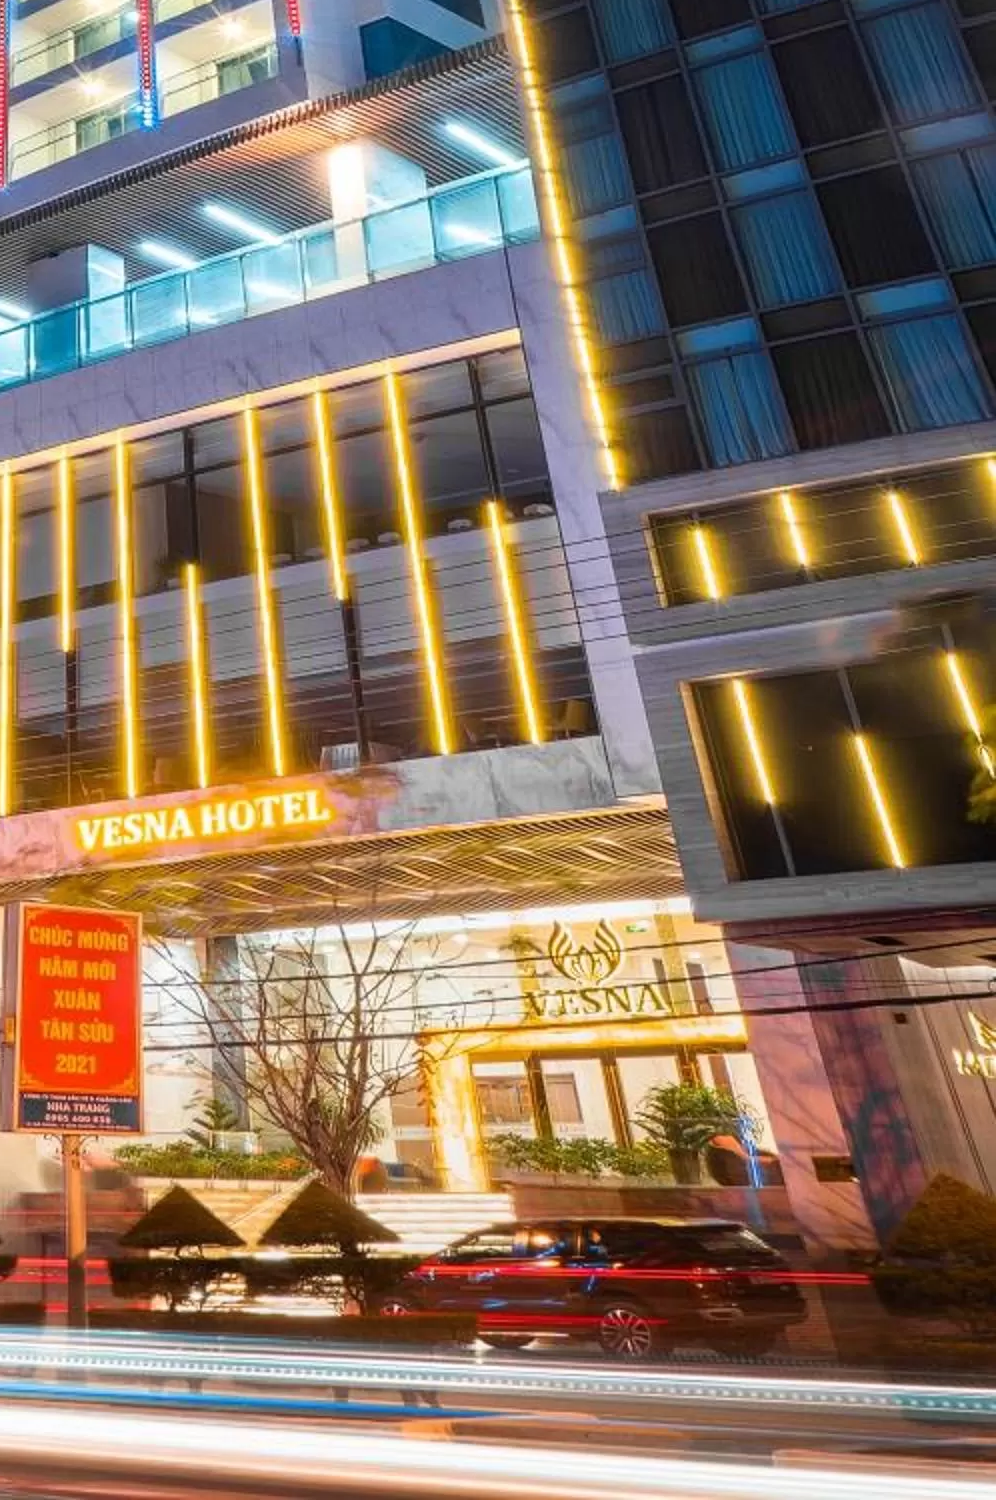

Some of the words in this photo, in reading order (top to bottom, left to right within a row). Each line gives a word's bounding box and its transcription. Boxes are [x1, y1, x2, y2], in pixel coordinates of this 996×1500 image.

[78, 811, 194, 850] VESNA
[201, 790, 331, 835] HOTEL
[29, 924, 73, 947] CHÚC
[53, 987, 101, 1011] XUÂN
[525, 984, 670, 1018] VESNA
[40, 1018, 74, 1041] TÂN
[55, 1052, 97, 1075] 2021
[46, 1102, 71, 1112] NHA
[73, 1103, 110, 1113] TRANG
